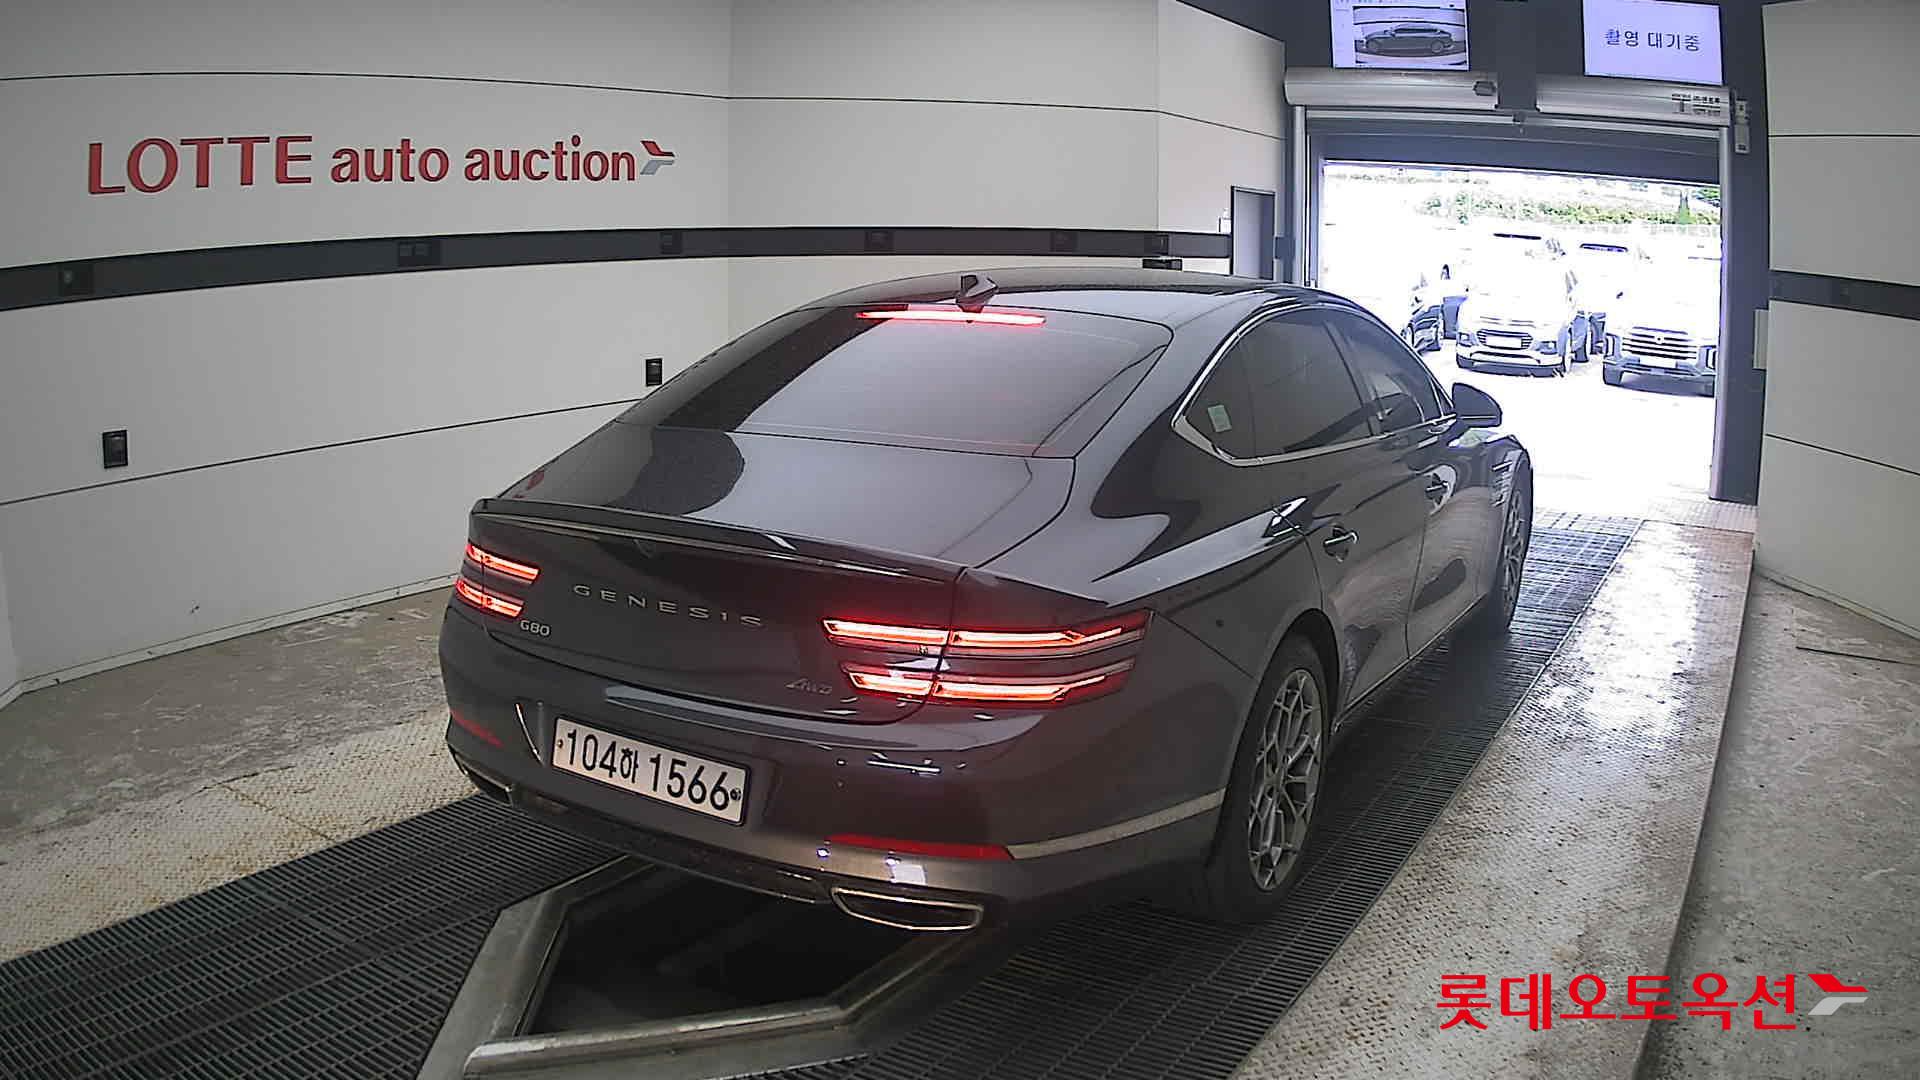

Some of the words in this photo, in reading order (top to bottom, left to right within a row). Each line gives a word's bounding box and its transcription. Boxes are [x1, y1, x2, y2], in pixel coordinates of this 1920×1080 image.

[1647, 32, 1701, 52] 대기중
[87, 134, 313, 195] LOTTE
[330, 137, 450, 184] auto
[463, 133, 637, 183] auction
[573, 584, 763, 627] GENESIS
[519, 618, 551, 638] G80
[567, 729, 640, 784] 104하
[649, 753, 731, 812] 1566
